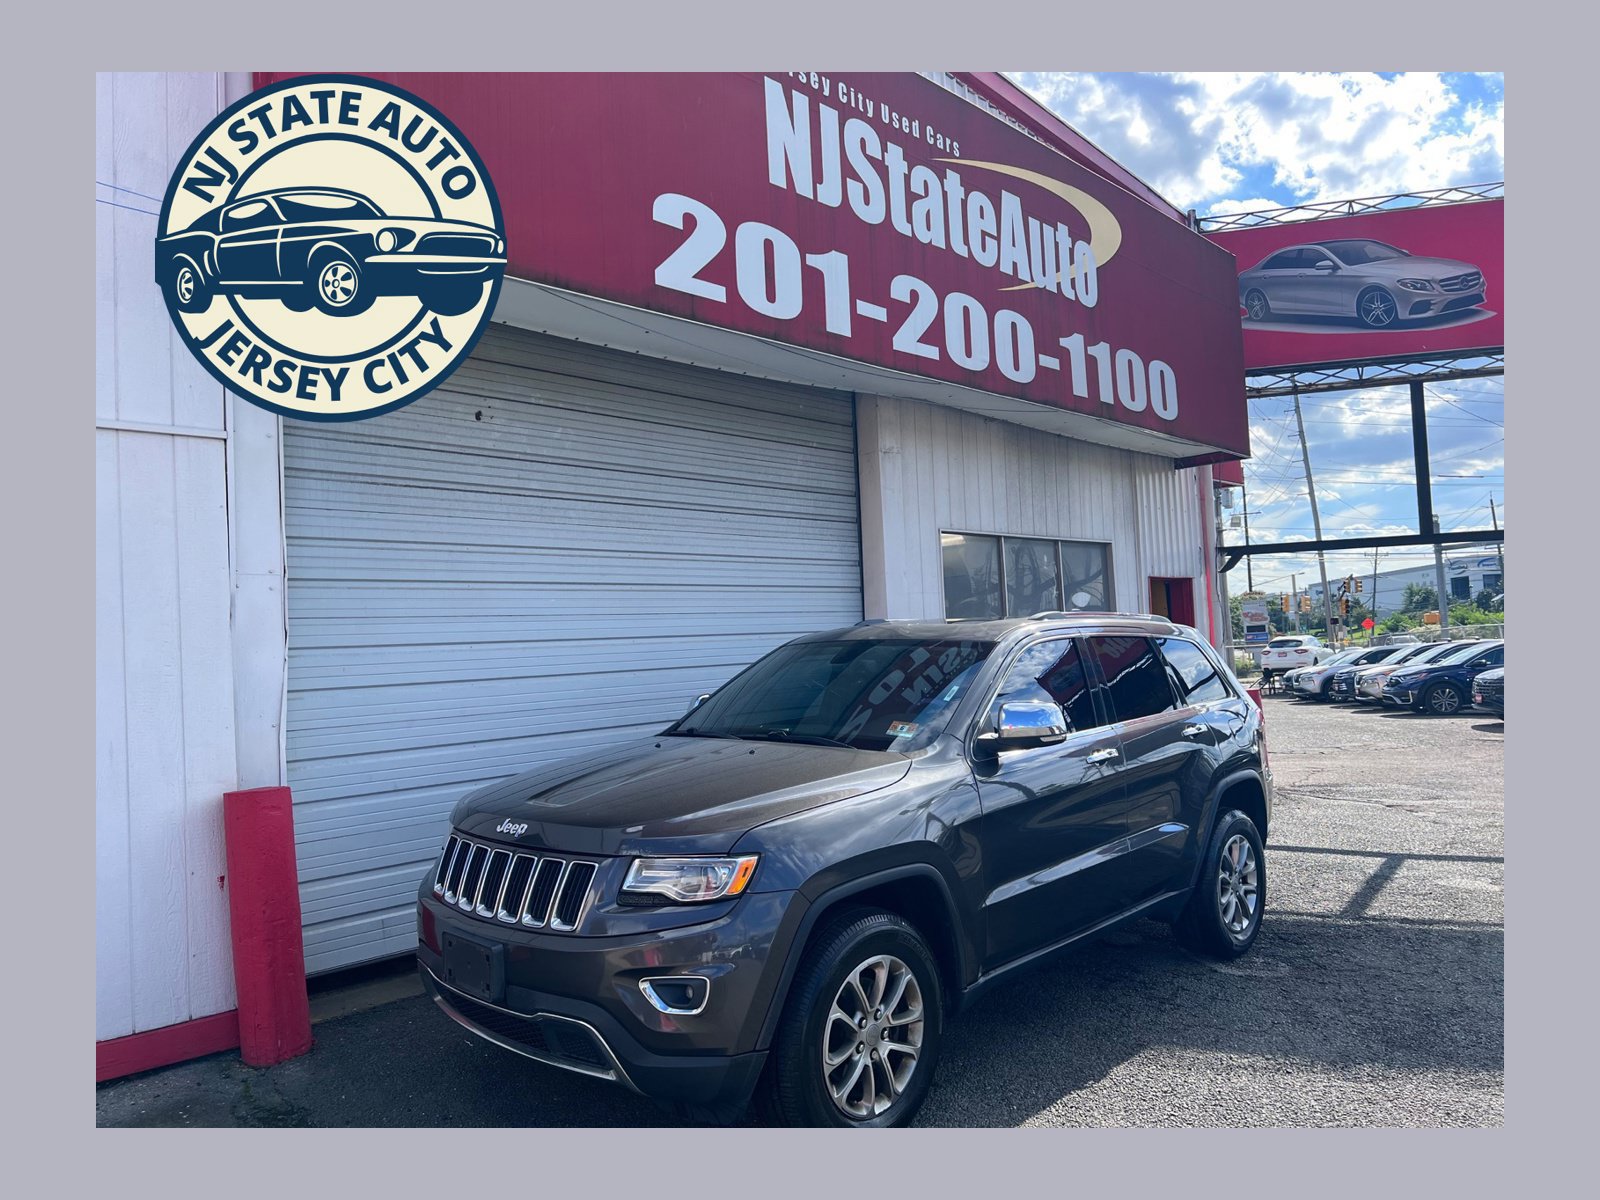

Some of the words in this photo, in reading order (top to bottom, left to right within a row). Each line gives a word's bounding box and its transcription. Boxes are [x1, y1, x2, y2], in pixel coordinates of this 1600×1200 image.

[764, 76, 1098, 308] NJStateAuto
[838, 82, 874, 118] City
[880, 103, 920, 139] Used
[926, 125, 960, 158] Cars
[652, 192, 1178, 421] 201-200-1100
[496, 818, 528, 838] Jeep
